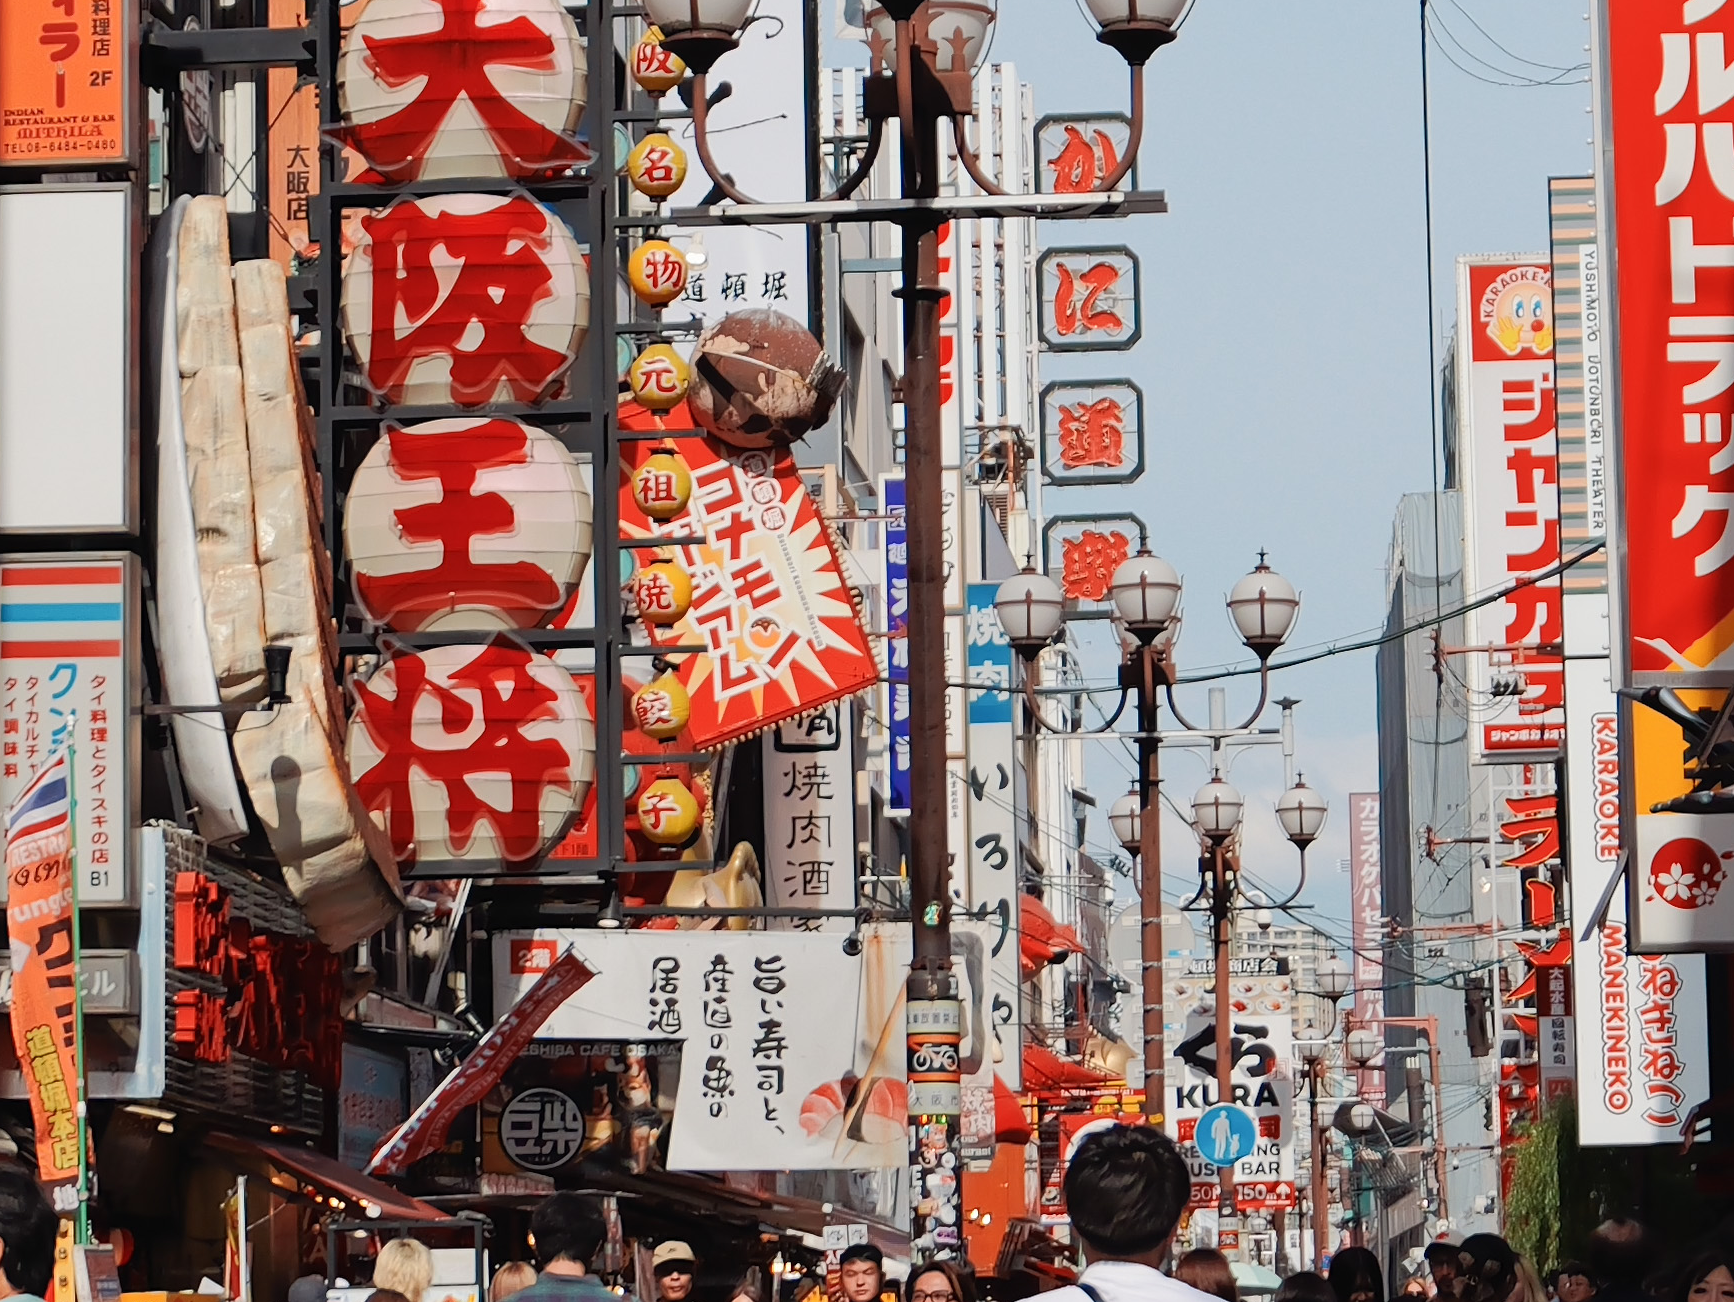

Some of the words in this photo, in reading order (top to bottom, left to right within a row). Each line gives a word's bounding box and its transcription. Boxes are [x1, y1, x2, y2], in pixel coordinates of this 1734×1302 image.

[3, 108, 45, 117] INDIAN
[89, 70, 113, 88] 2F
[3, 116, 79, 126] RESTAURANT
[286, 145, 309, 222] 大阪店
[1591, 455, 1604, 531] THEATER
[966, 604, 1010, 703] 焼肉
[90, 674, 110, 865] タイ料理とタイスキの店
[1592, 713, 1621, 862] KARAOKE
[1601, 923, 1632, 1114] MANEKINEKO
[1638, 954, 1682, 1127] ねきねこ
[1176, 1081, 1281, 1109] KURA
[1241, 1160, 1281, 1176] BAR
